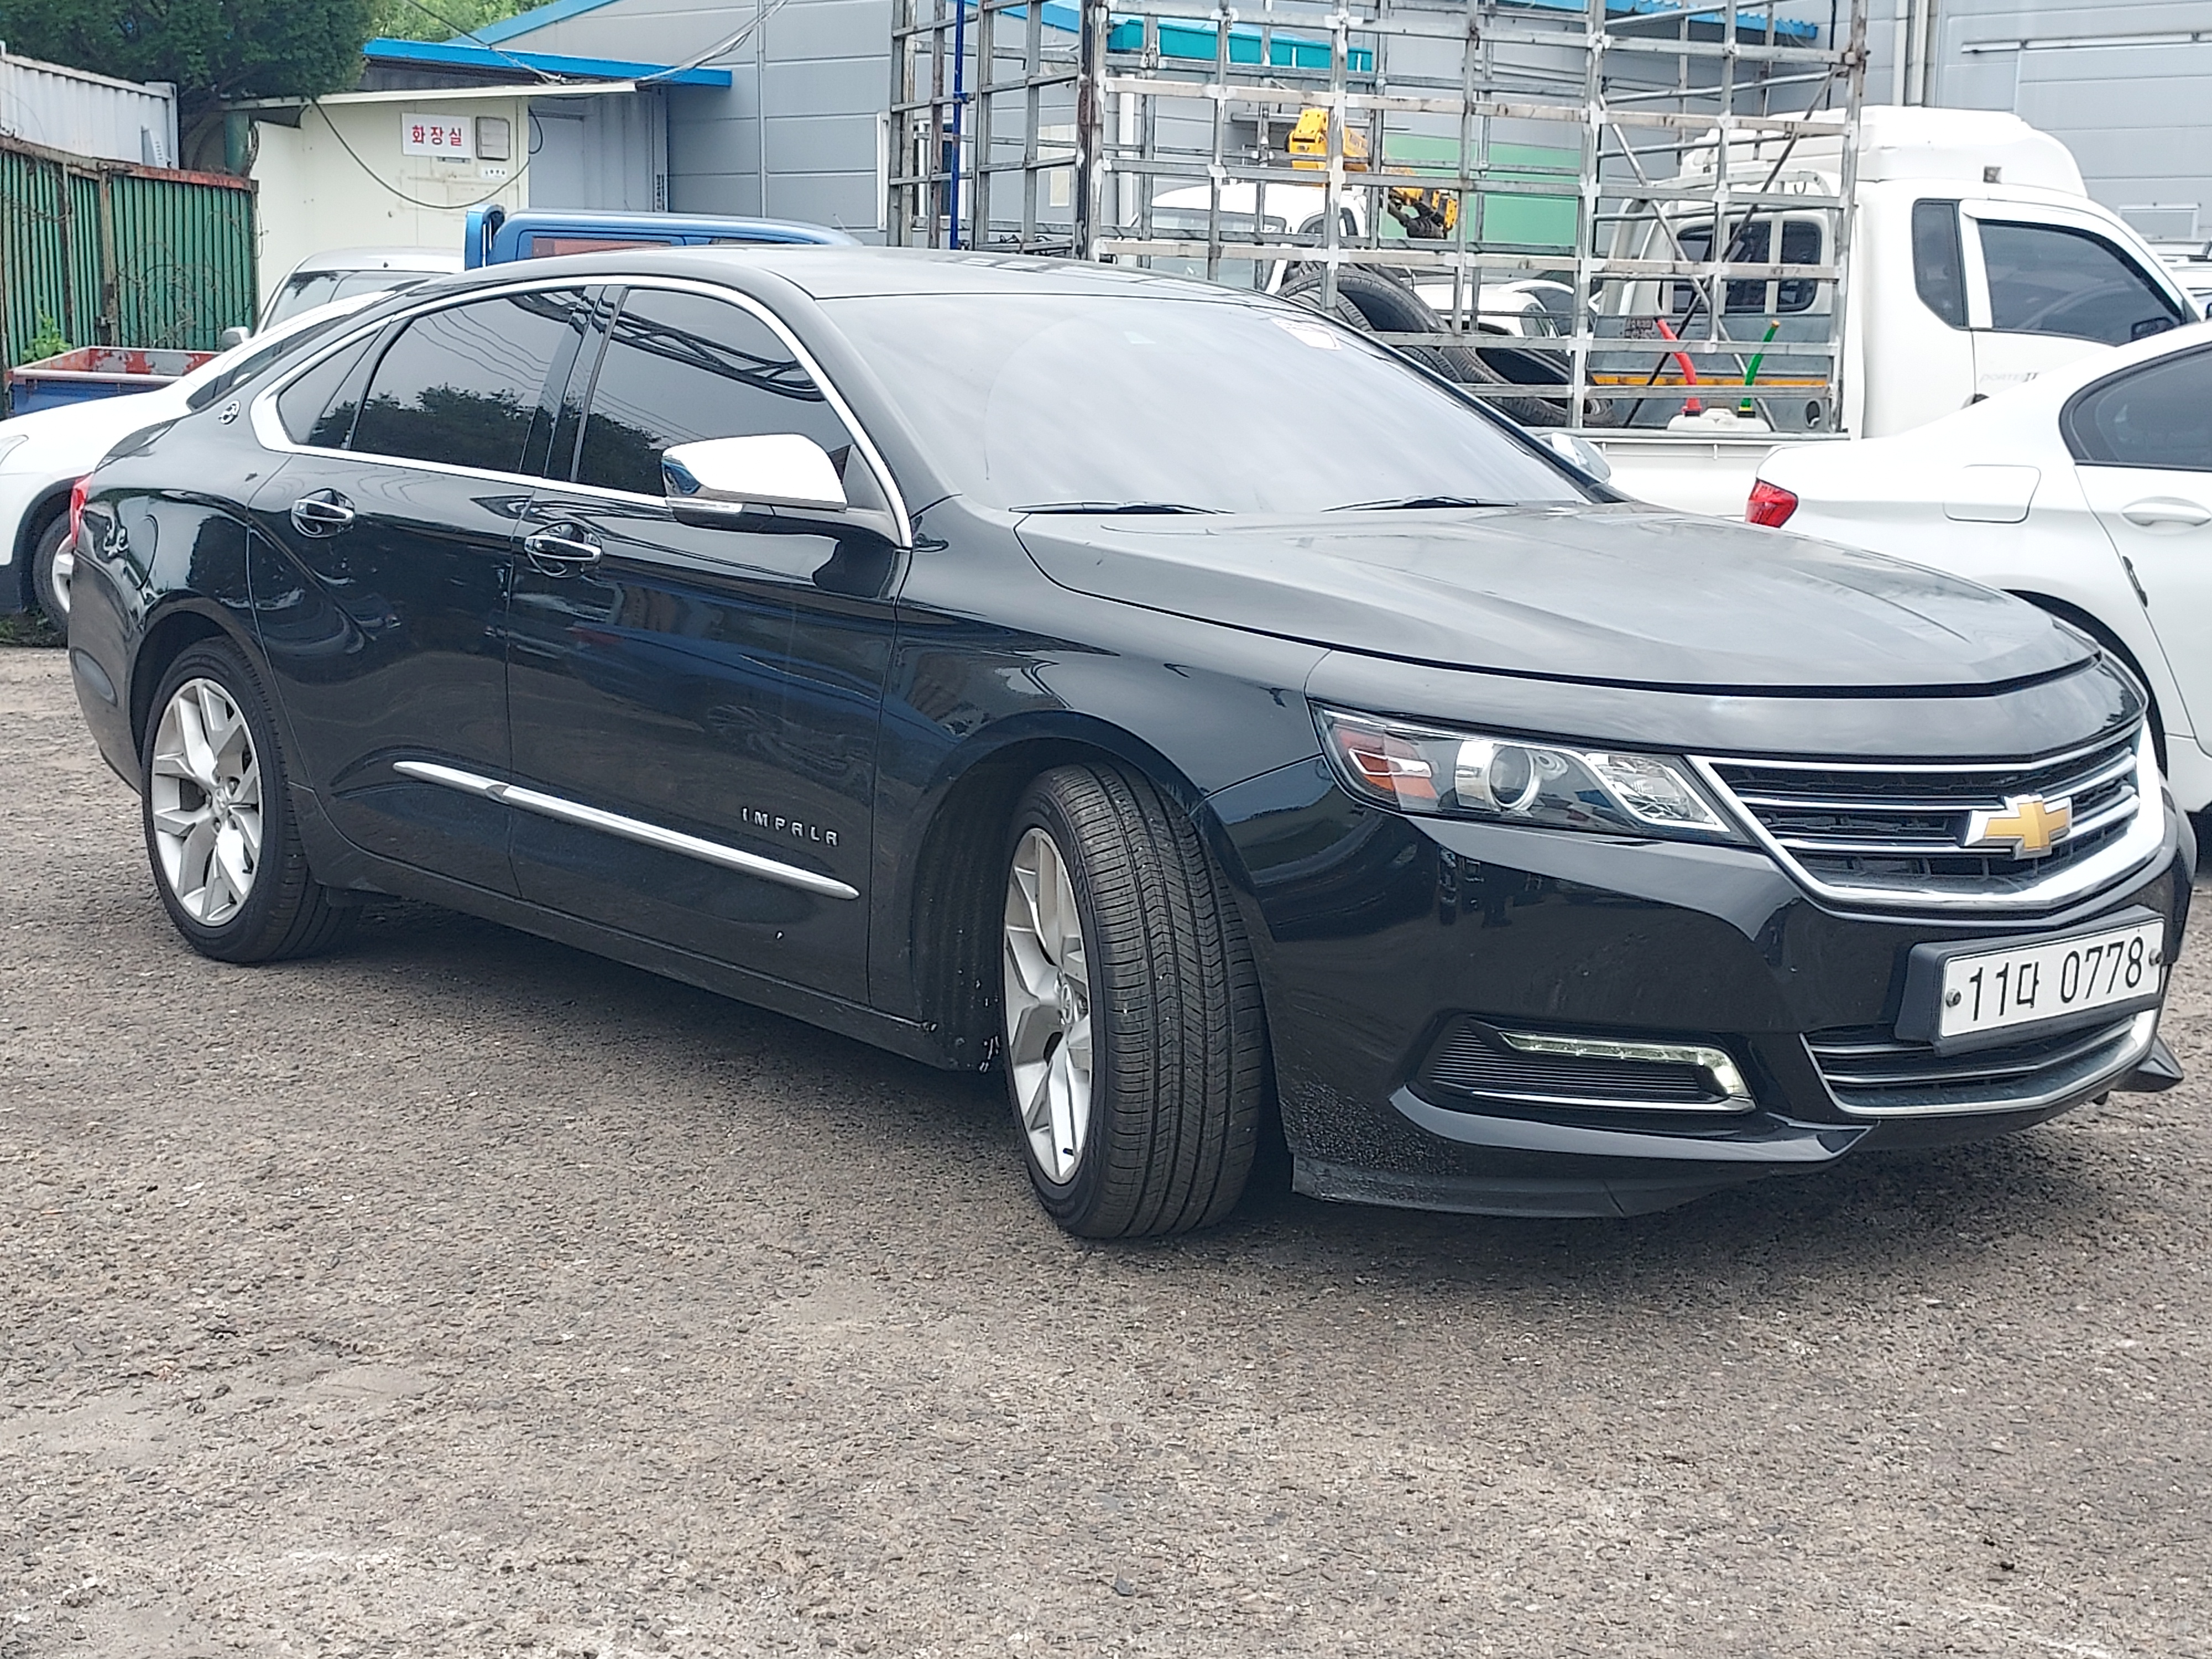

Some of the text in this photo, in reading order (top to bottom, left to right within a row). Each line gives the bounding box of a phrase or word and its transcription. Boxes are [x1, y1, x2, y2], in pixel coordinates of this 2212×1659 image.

[412, 125, 462, 147] 화장실
[742, 807, 838, 847] IMPALA
[2059, 936, 2145, 1004] 0778
